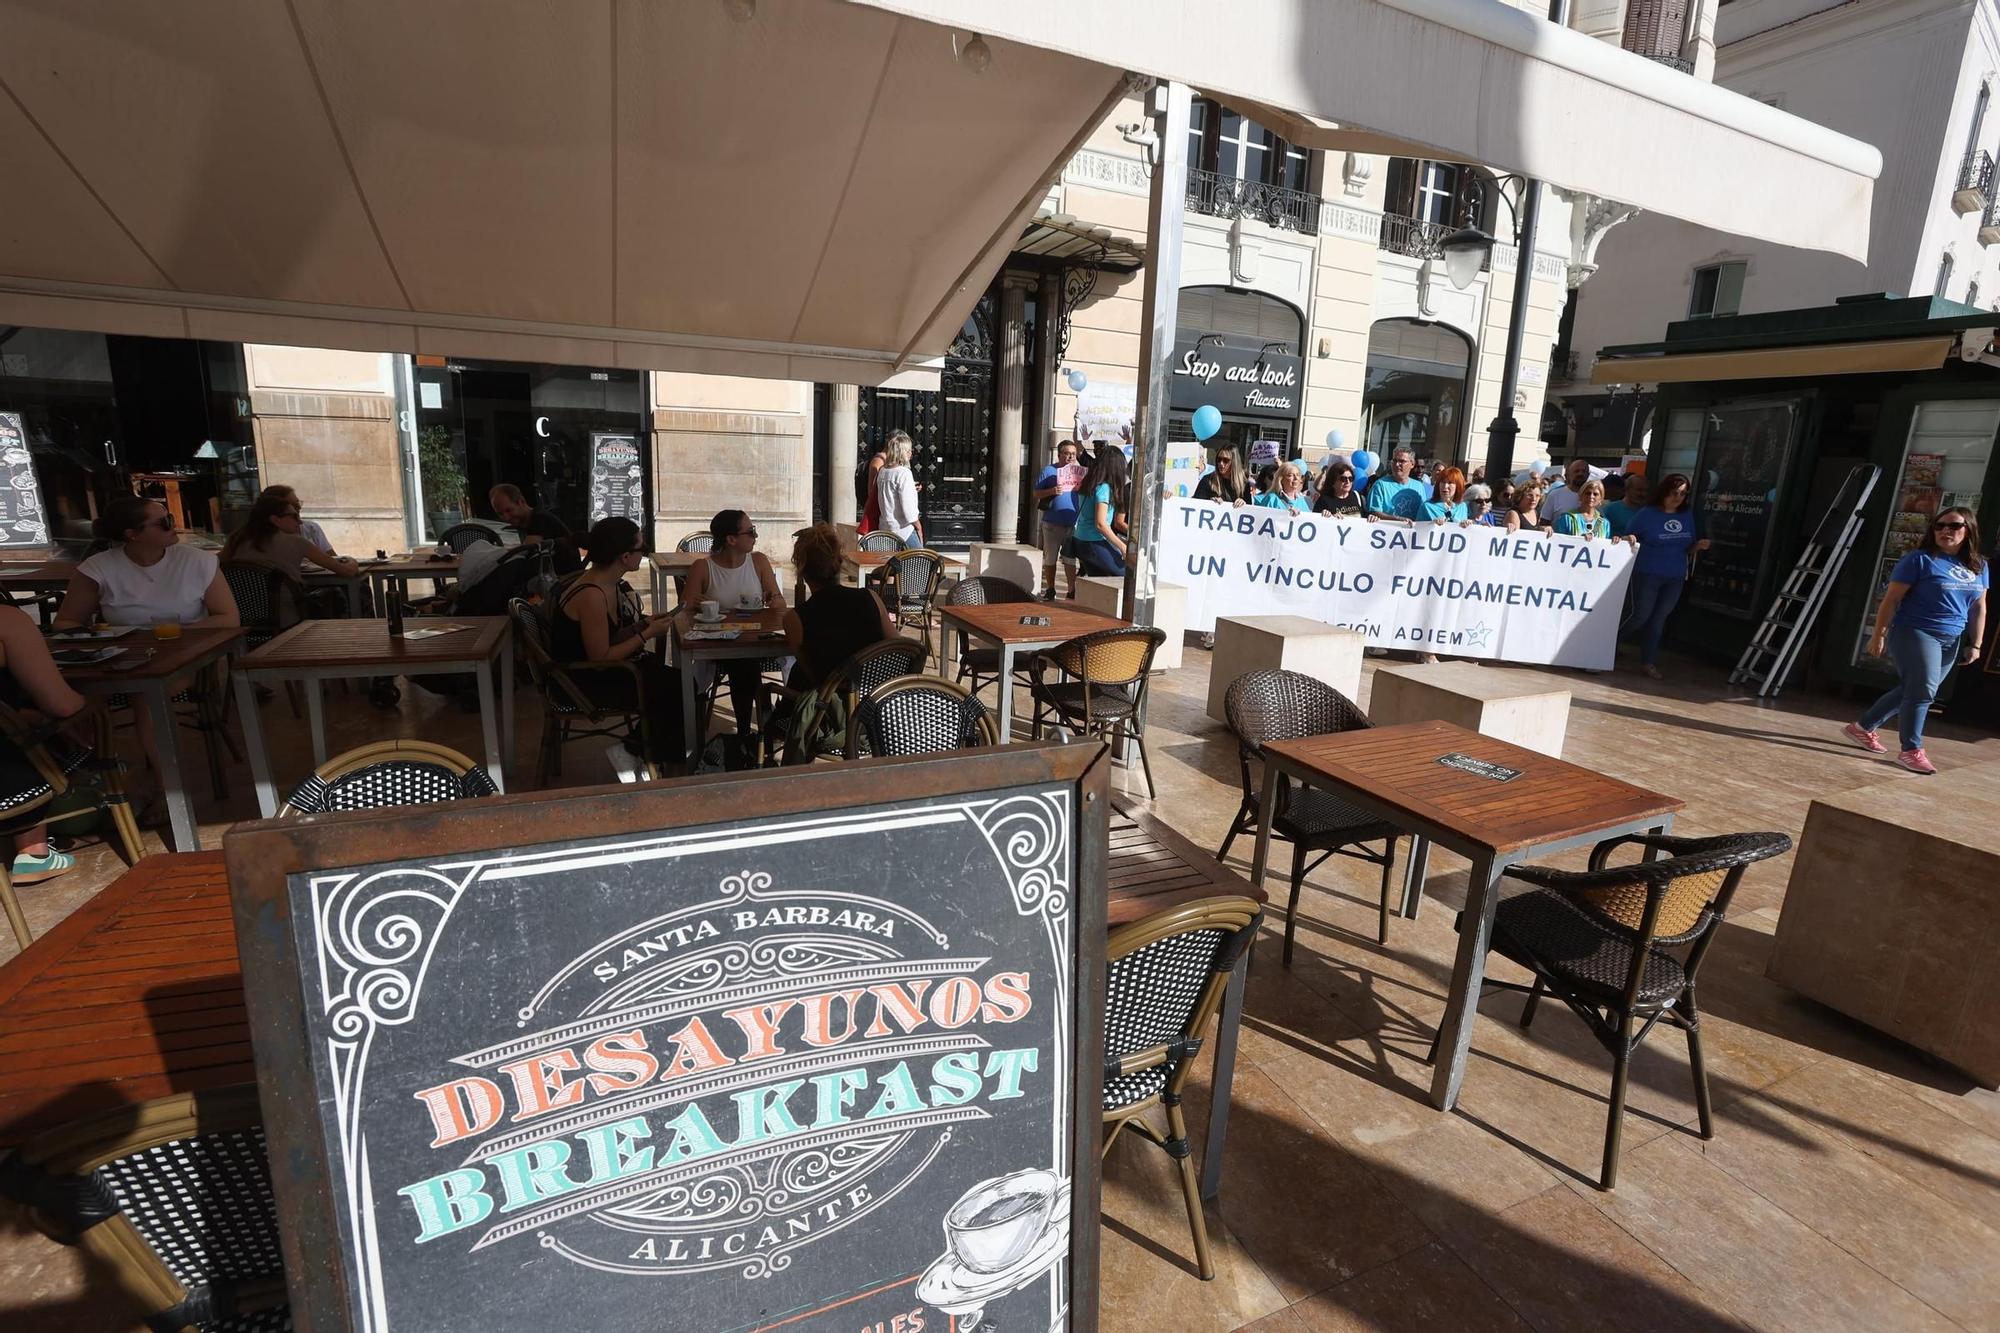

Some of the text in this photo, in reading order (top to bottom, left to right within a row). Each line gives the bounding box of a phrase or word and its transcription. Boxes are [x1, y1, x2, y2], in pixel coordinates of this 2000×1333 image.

[1174, 350, 1296, 386] Stop and look
[535, 416, 550, 438] C
[1245, 389, 1292, 409] Alicante
[1180, 506, 1612, 569] TRABAJO Y SALUD MENTAL
[1187, 553, 1593, 613] UN VÍNCULO FUNDAMENTAL
[1395, 627, 1464, 646] ADIEM
[593, 906, 896, 984] SANTA BARBARA
[413, 972, 1033, 1149] DESAYUNOS
[397, 1048, 1039, 1244] BREAKFAST
[628, 1182, 873, 1261] ALICANTE
